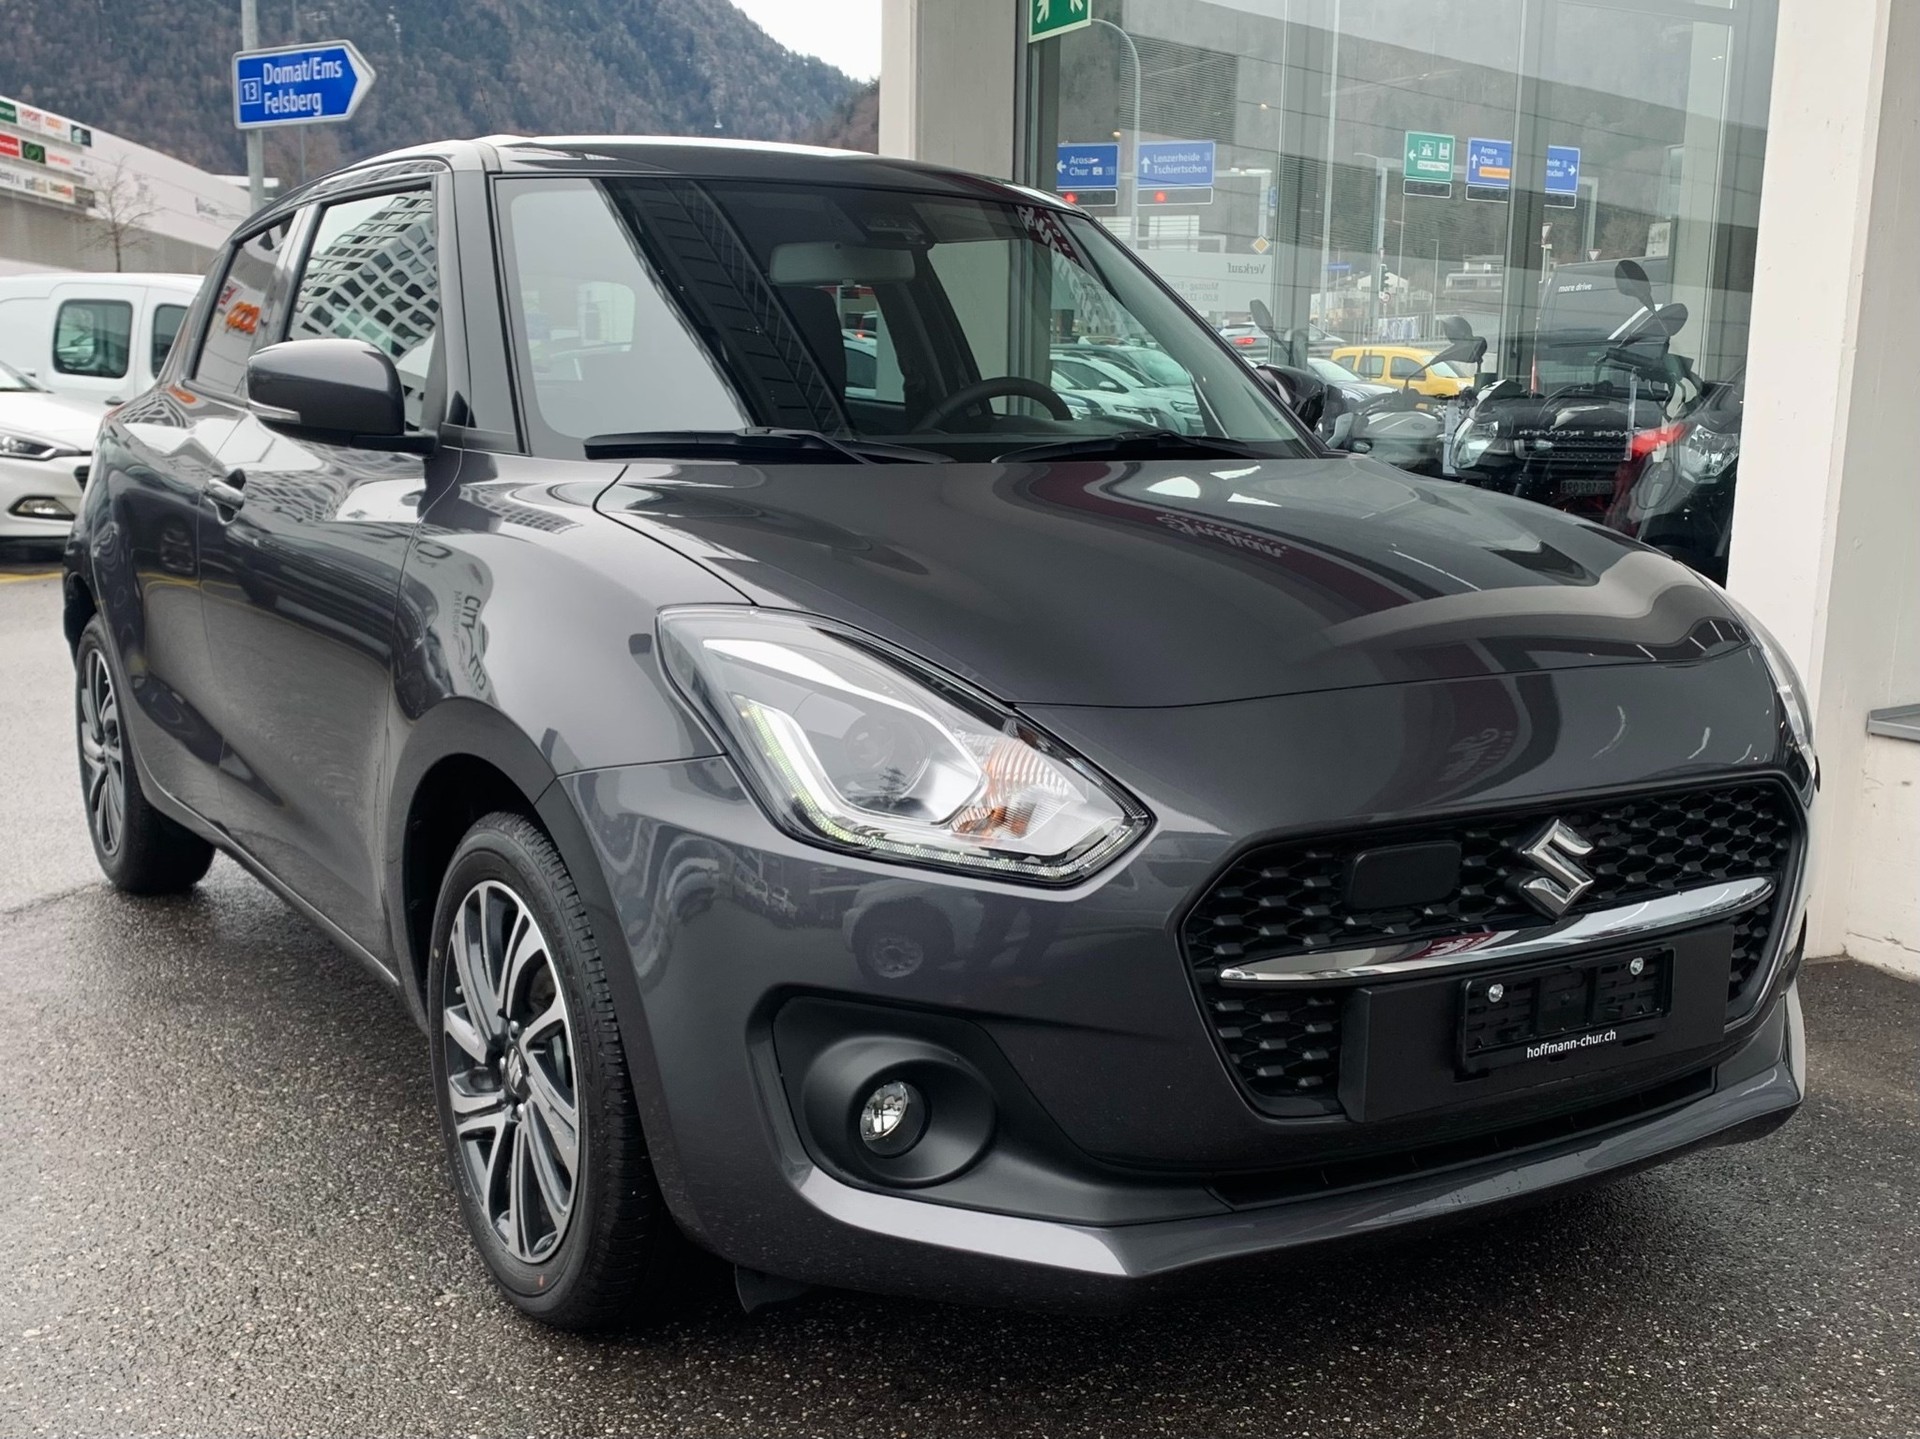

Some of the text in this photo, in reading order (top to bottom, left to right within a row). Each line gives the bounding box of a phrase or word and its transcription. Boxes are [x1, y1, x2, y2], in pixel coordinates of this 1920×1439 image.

[263, 56, 343, 86] Domat/Ems
[243, 82, 257, 101] 13
[264, 88, 322, 116] Felsberg
[1153, 152, 1200, 163] Lenzerheide
[1069, 166, 1089, 176] Chur
[1153, 163, 1208, 175] Tschiertschen
[1576, 282, 1592, 290] drive
[1526, 1029, 1616, 1058] hoffmann-chur.ch
